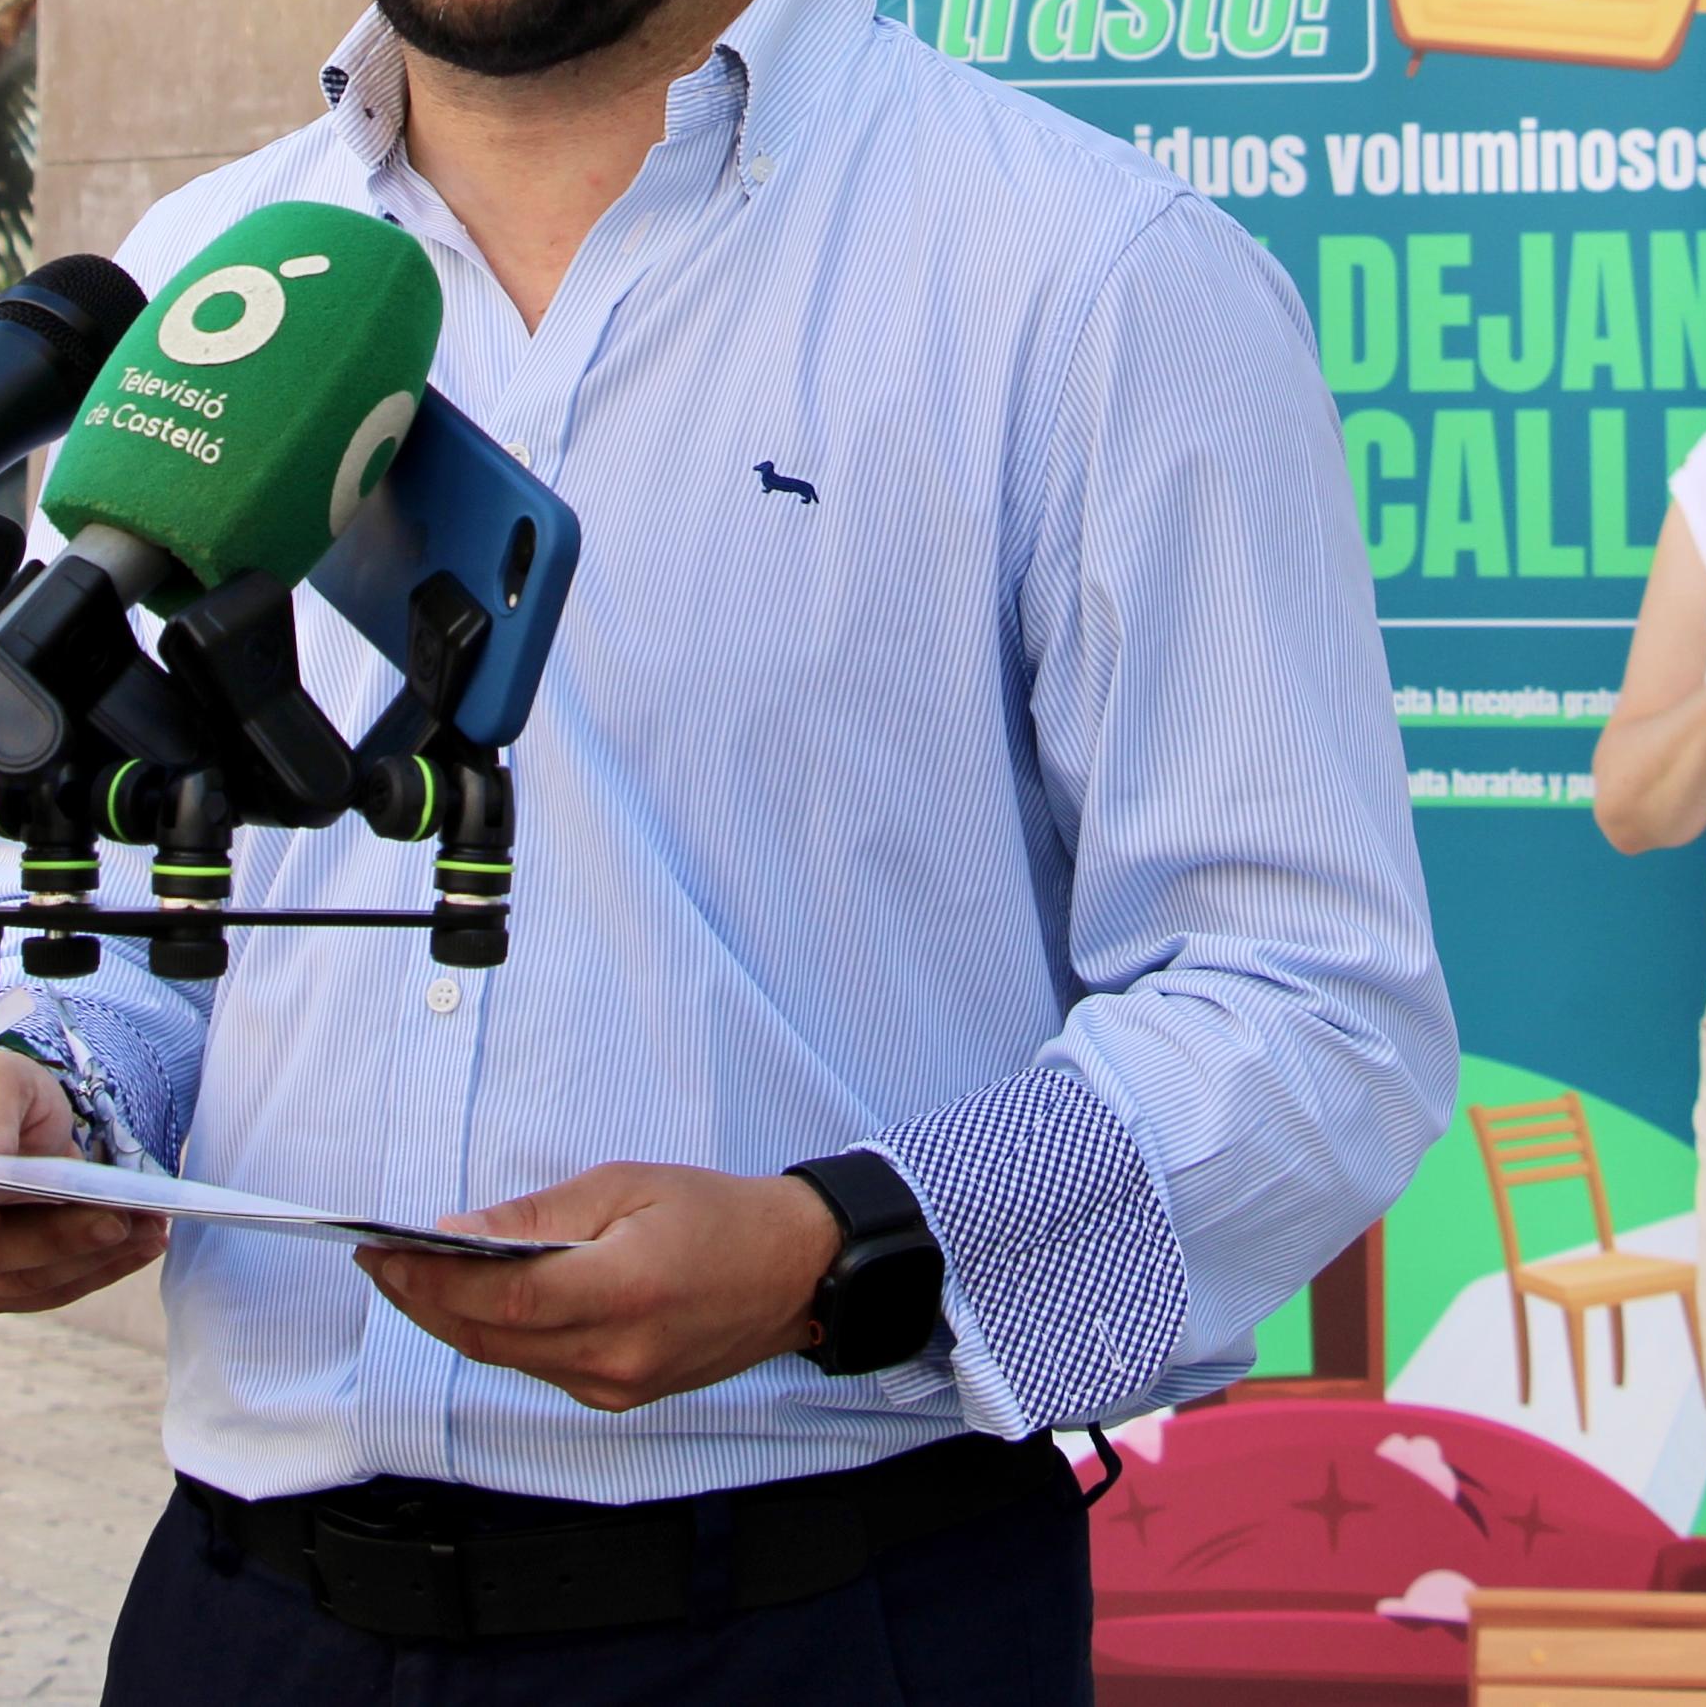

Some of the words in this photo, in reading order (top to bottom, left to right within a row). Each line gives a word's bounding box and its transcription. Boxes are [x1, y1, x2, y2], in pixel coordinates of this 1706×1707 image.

[1133, 124, 1307, 197] iduos
[117, 366, 228, 421] Televisió
[84, 401, 111, 427] de
[111, 402, 226, 465] Castelló
[1461, 685, 1560, 718] recogida
[1451, 767, 1545, 798] horarios
[1547, 773, 1563, 803] y
